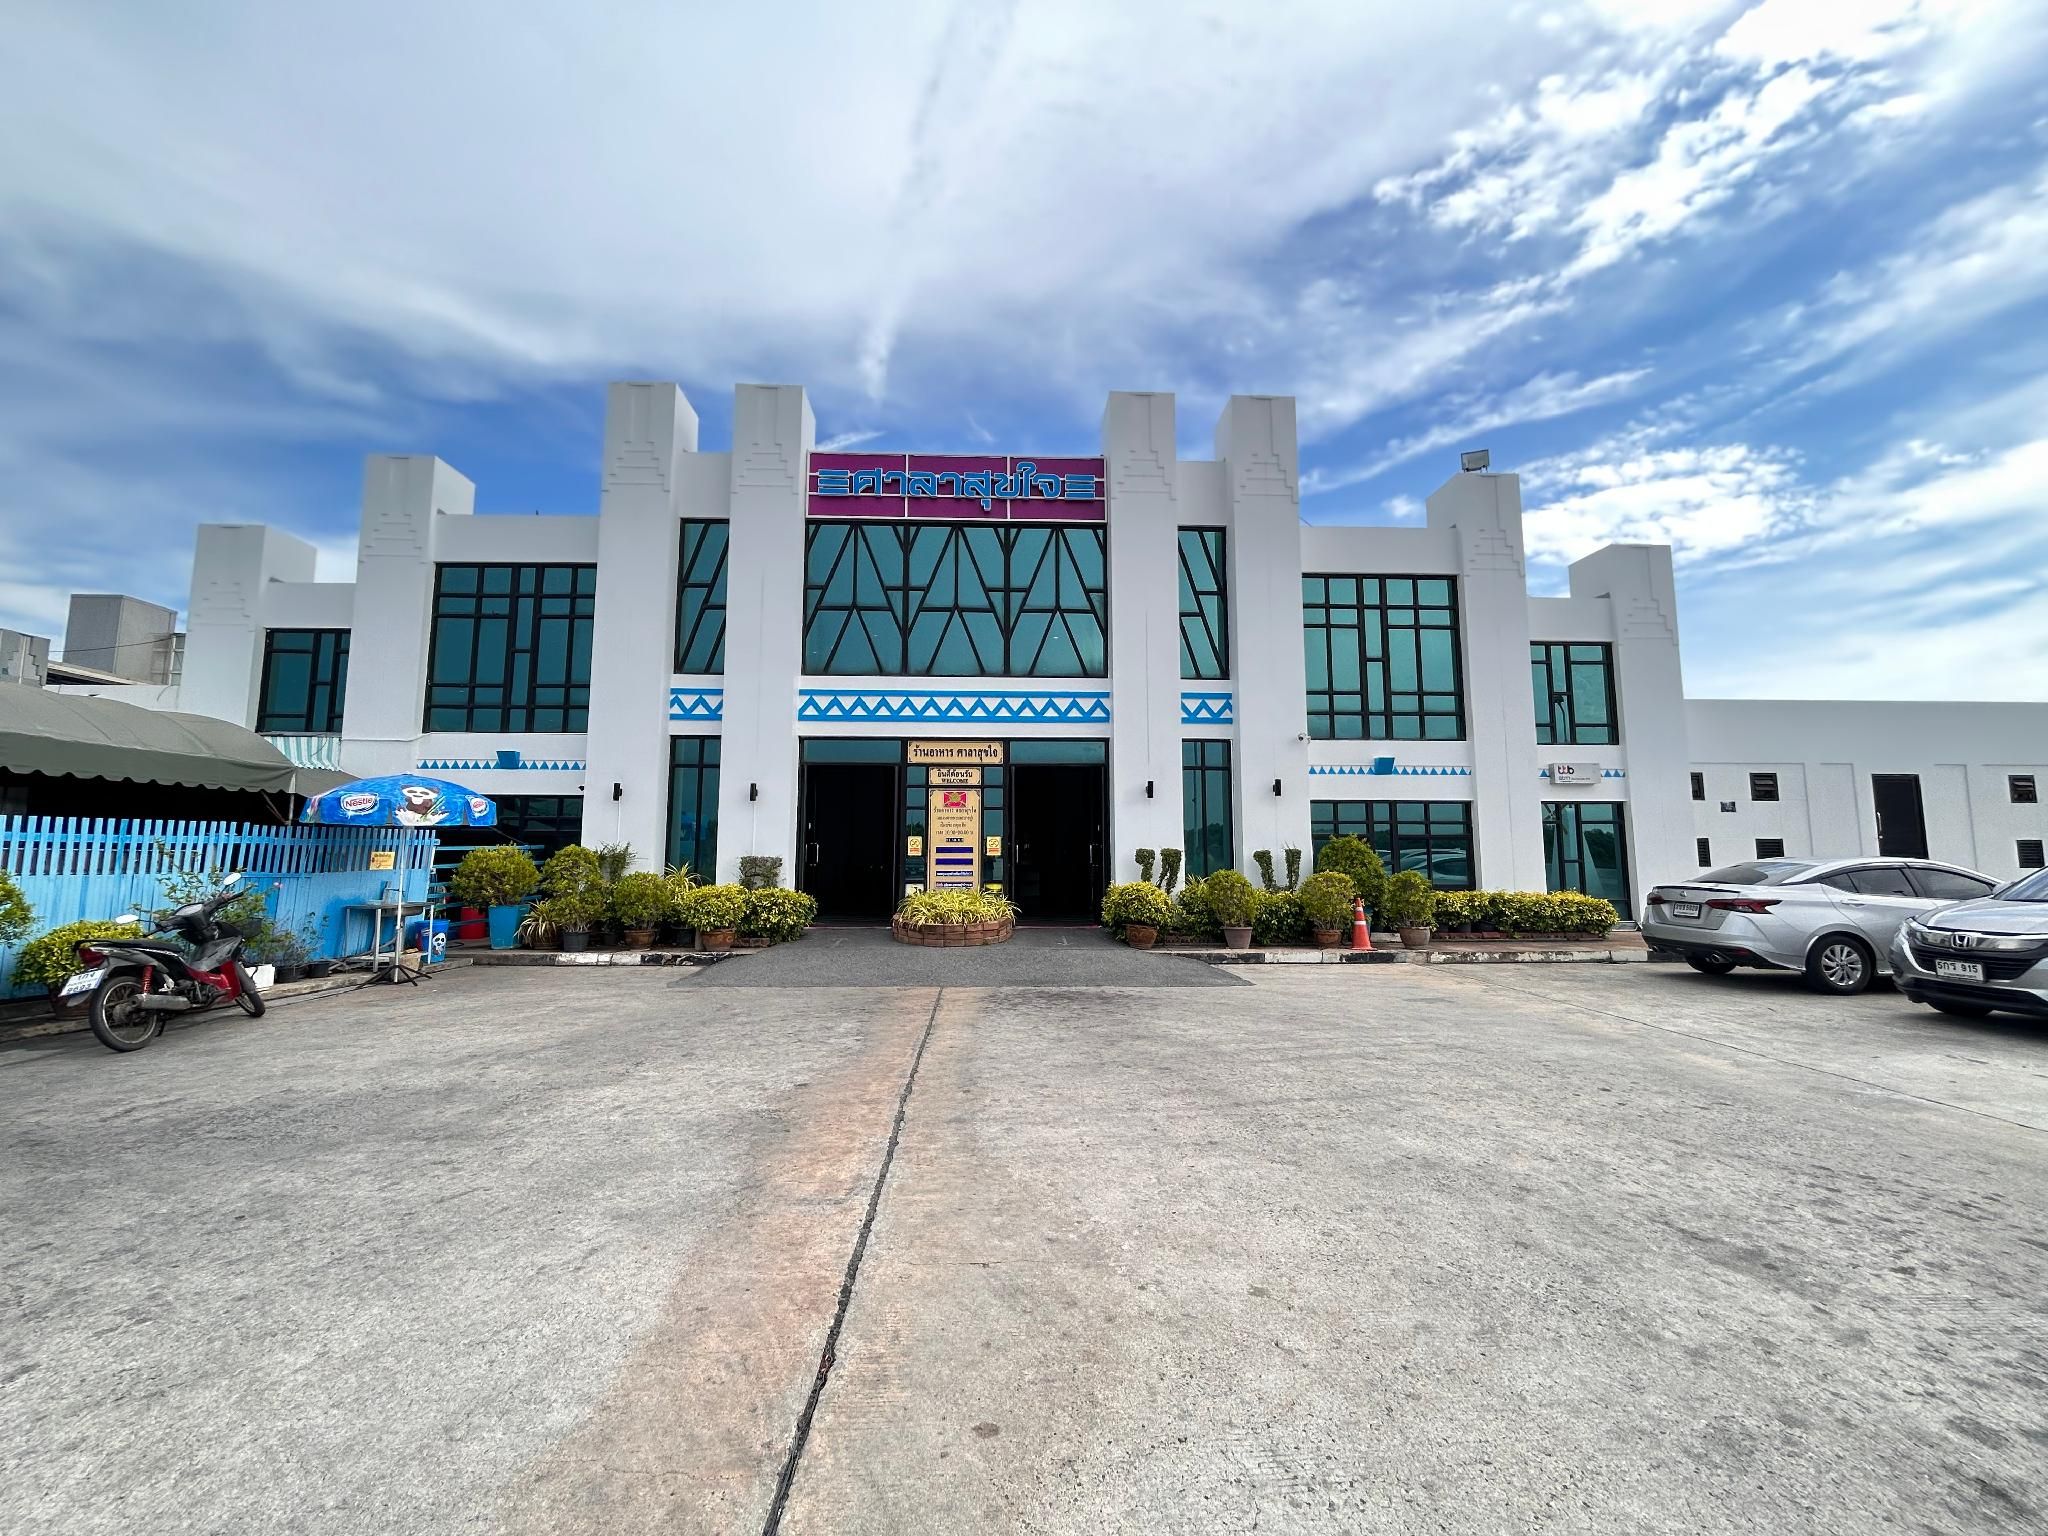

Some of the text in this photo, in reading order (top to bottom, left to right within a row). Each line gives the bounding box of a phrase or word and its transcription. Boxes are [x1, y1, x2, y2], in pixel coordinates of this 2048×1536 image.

[853, 461, 1062, 512] ศาลาสุขใจ
[913, 744, 954, 758] ร้านอาหาร
